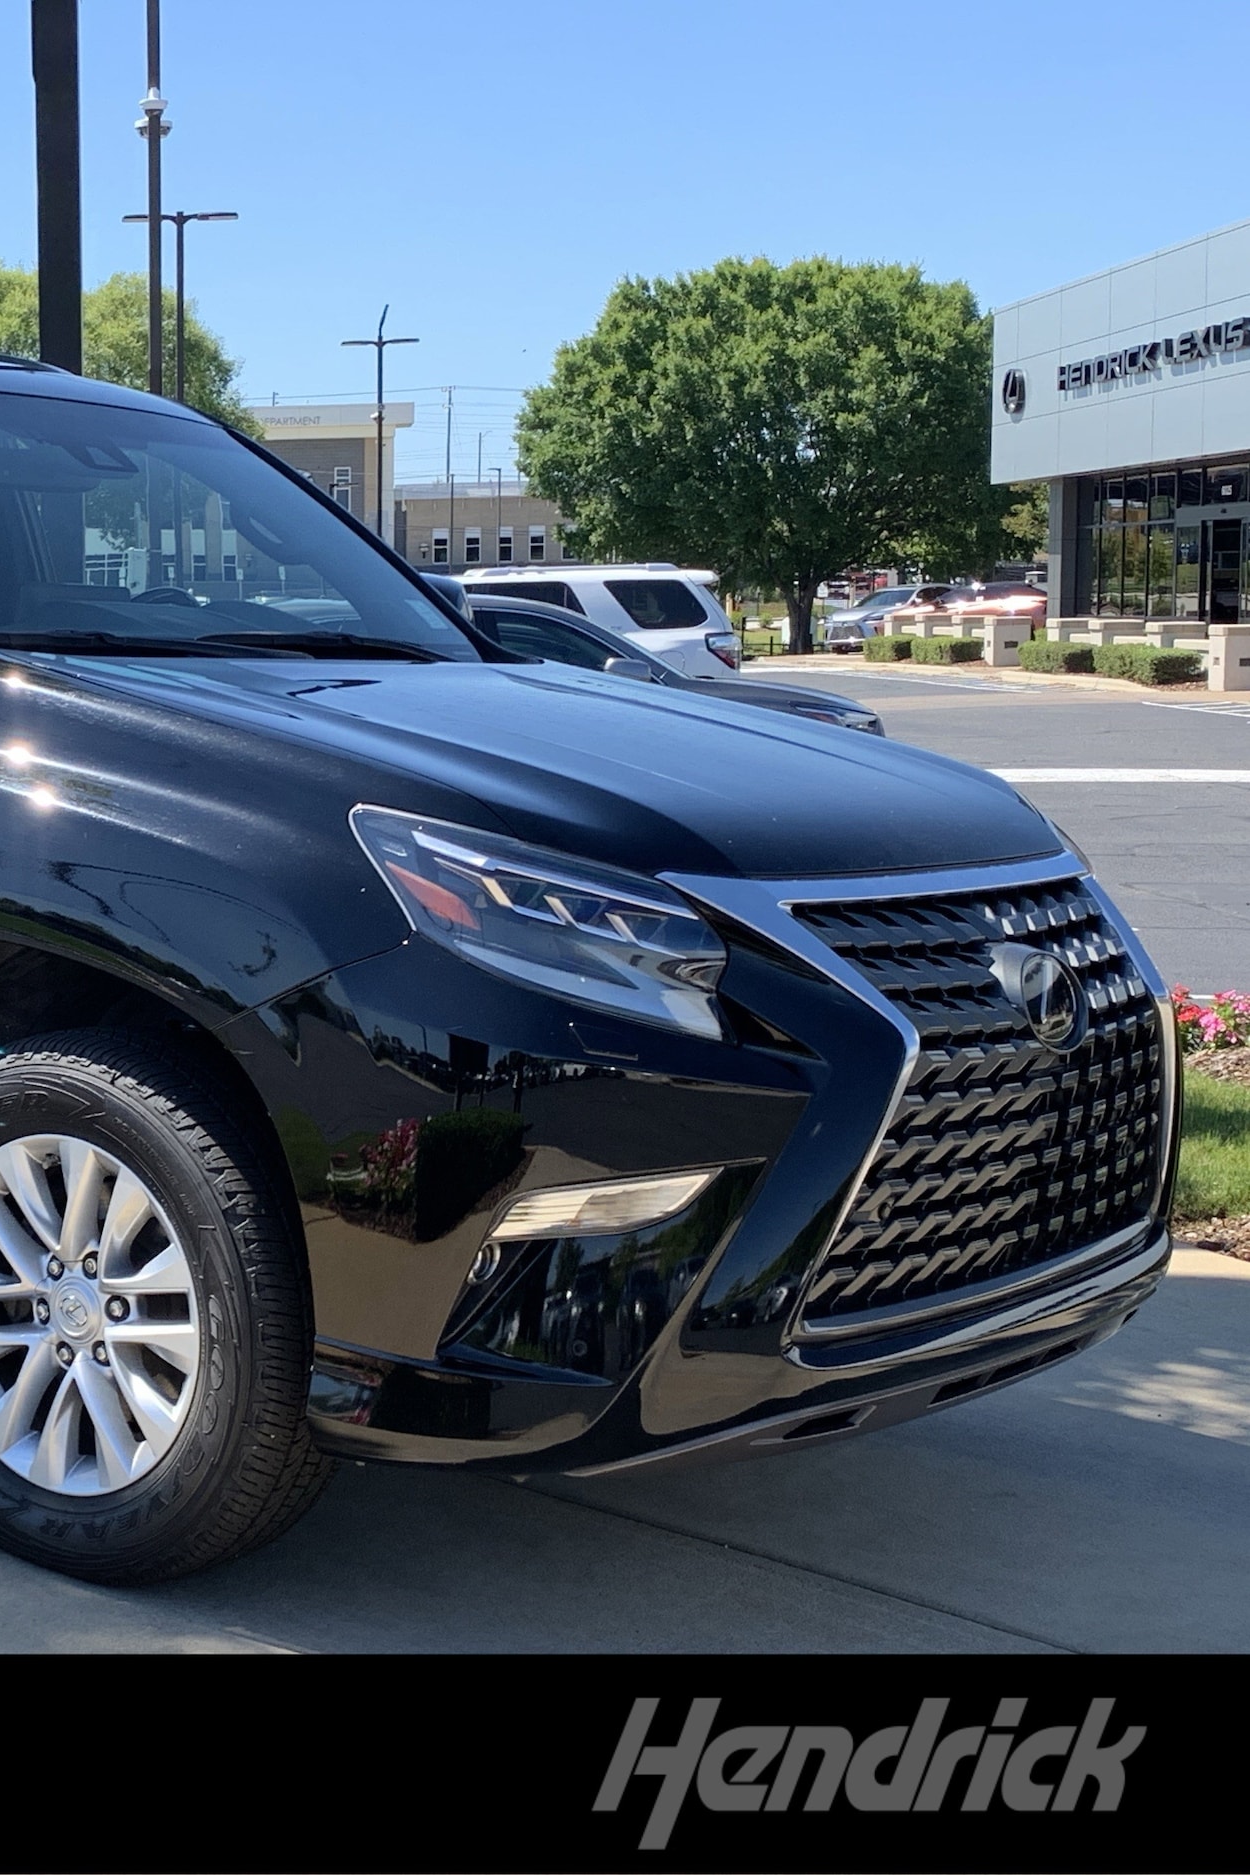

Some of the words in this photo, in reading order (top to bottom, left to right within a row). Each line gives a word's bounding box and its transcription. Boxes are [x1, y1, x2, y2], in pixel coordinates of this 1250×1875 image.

[1057, 342, 1161, 391] HENDRICK
[1162, 317, 1248, 365] LEXUS
[261, 415, 321, 426] EPARTMENT
[38, 1293, 226, 1542] GOODYEAR
